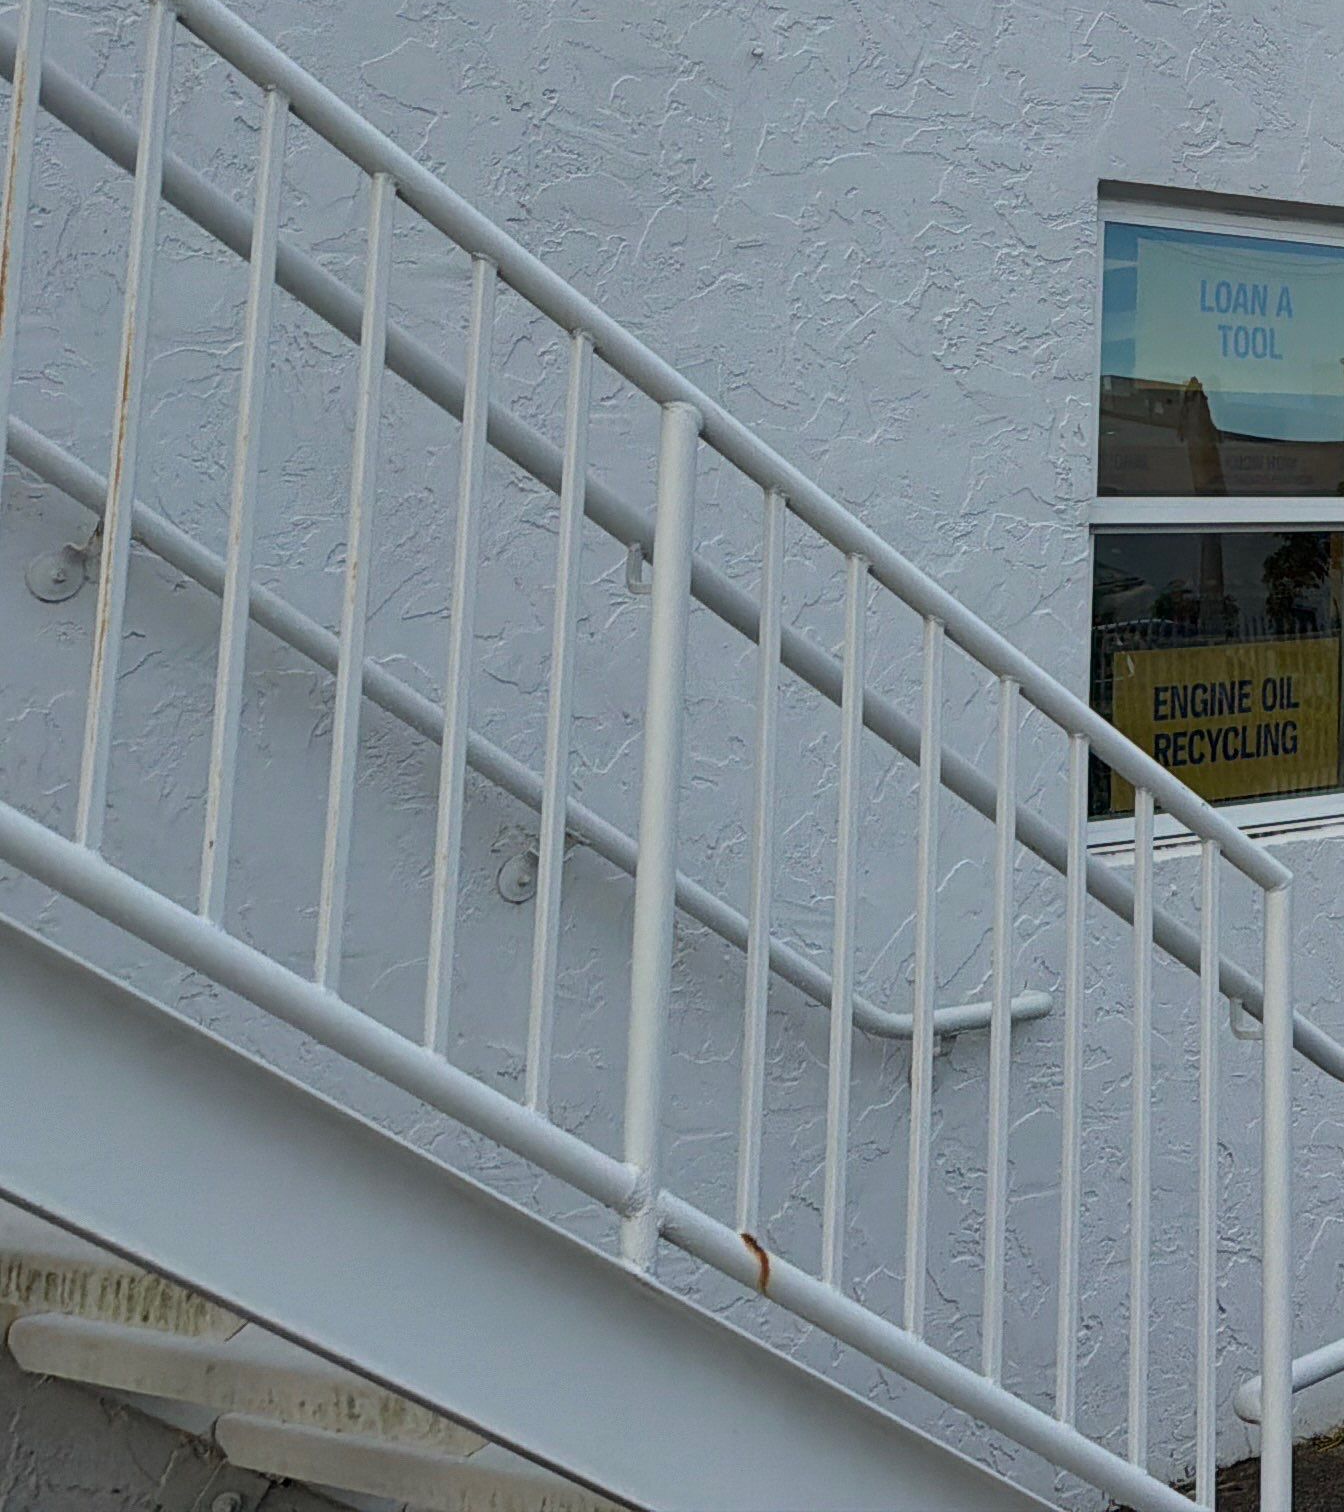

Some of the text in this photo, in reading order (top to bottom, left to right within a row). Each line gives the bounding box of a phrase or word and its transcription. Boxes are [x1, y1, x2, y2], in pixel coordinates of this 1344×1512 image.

[1200, 279, 1294, 319] LOAN A
[1217, 323, 1284, 360] TOOL
[1153, 676, 1300, 722] ENGINE OIL
[1153, 720, 1298, 768] RECYCLING
